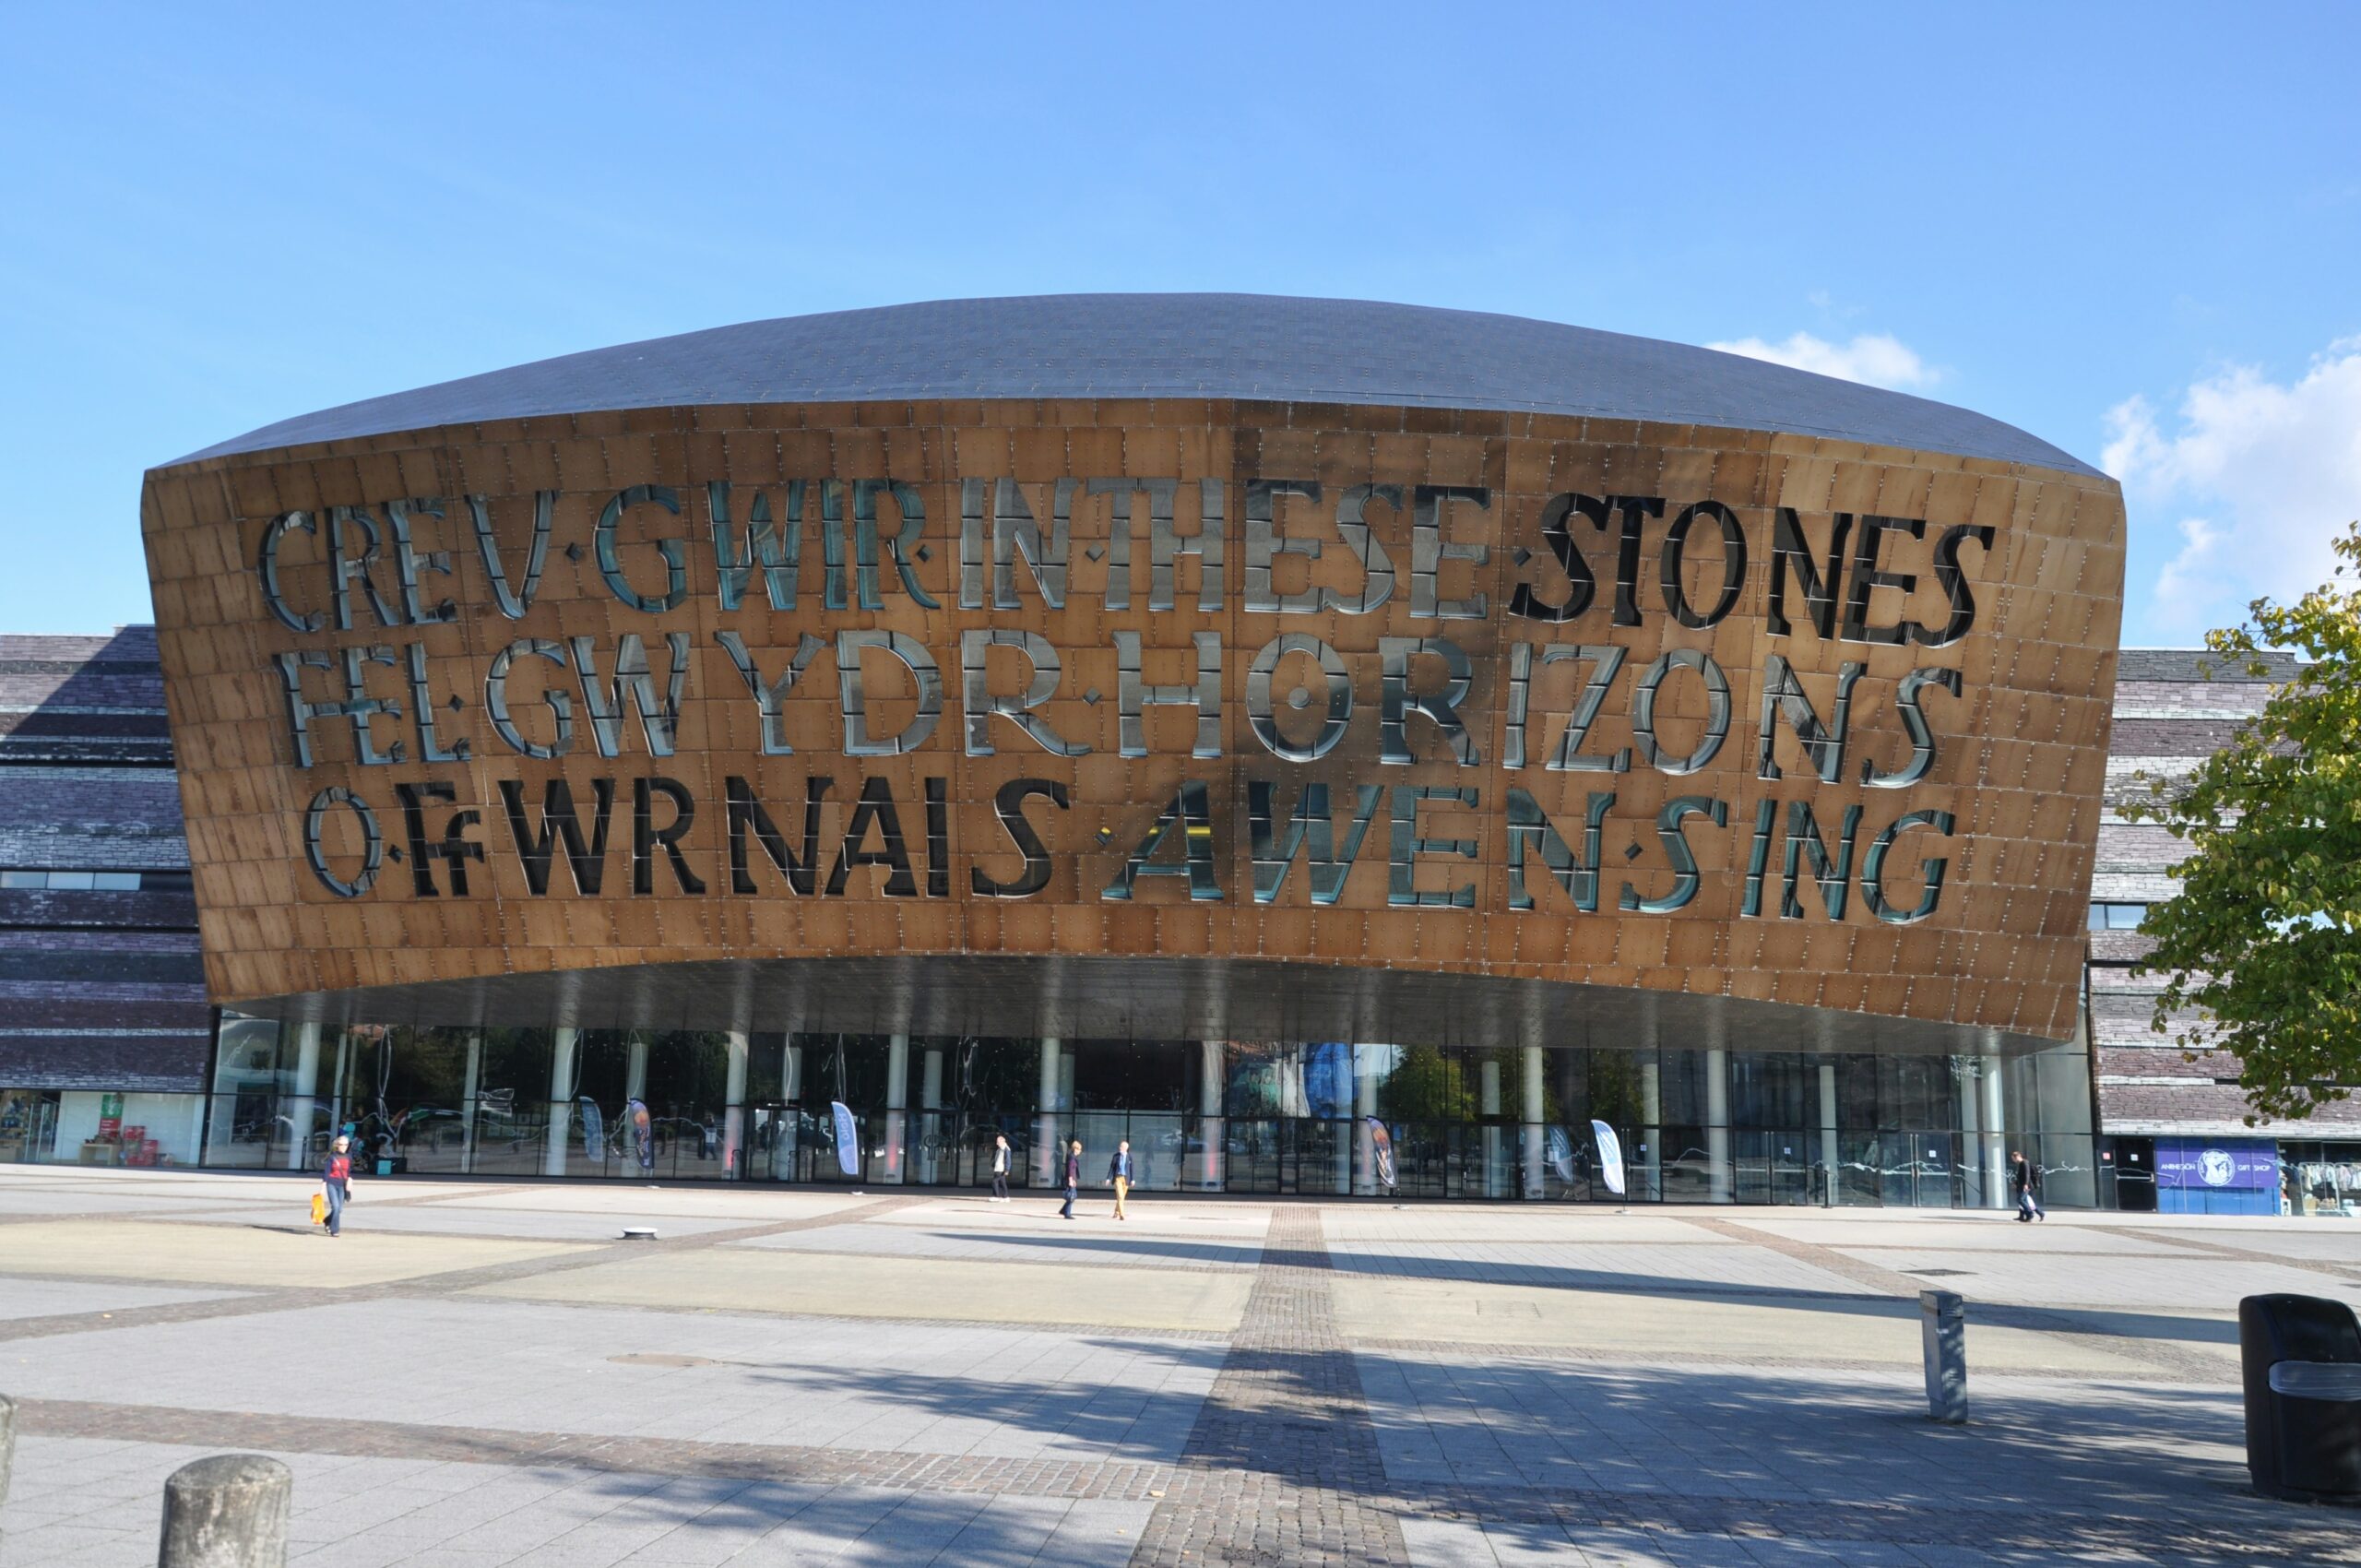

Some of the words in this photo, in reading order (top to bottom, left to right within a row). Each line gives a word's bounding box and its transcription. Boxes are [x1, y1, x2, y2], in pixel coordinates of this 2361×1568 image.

[594, 478, 941, 612] GWIR
[958, 477, 1081, 610] IN
[1086, 477, 1491, 619] THESE
[1508, 493, 1996, 648] STONES
[484, 629, 1094, 760] GWYDR
[1112, 632, 1963, 789] HORIZONS
[1101, 780, 1616, 914] AWEN
[1619, 796, 1955, 925] SING
